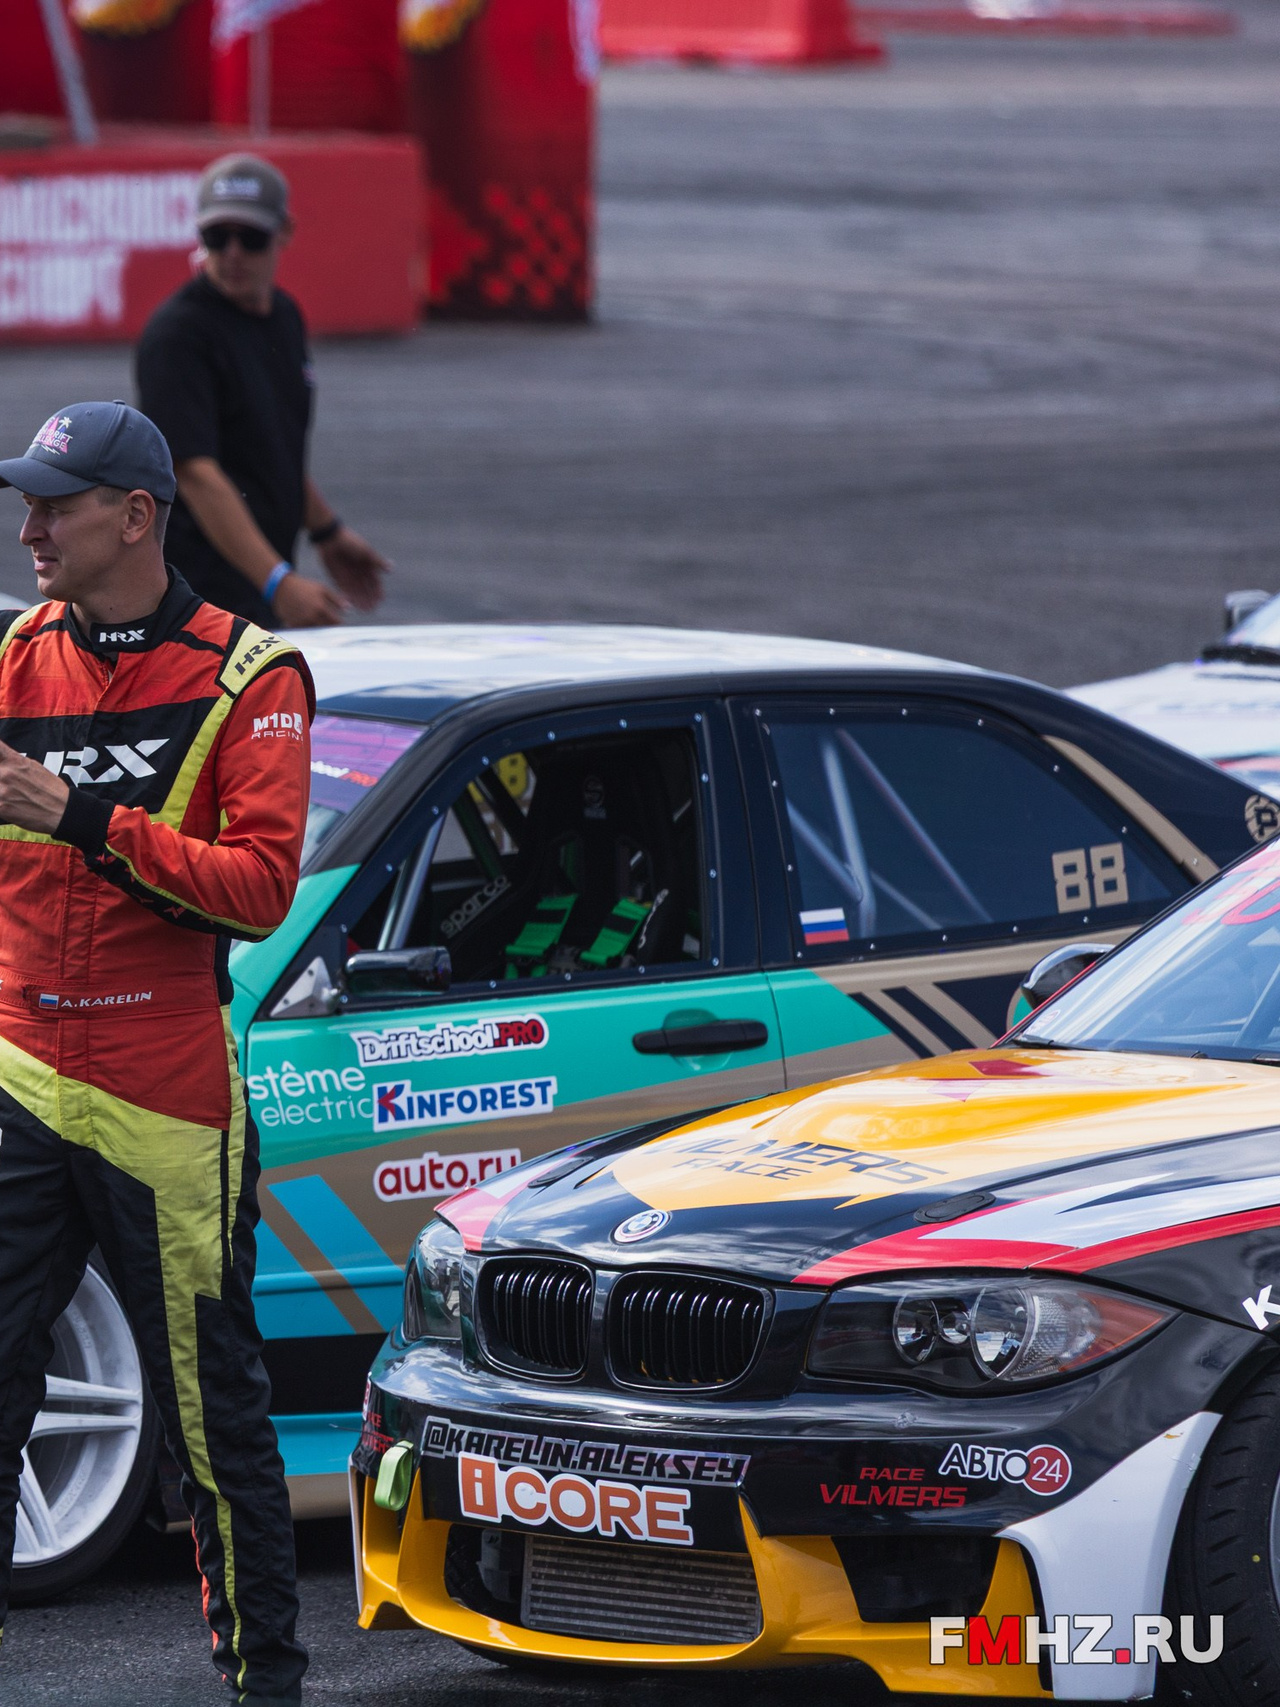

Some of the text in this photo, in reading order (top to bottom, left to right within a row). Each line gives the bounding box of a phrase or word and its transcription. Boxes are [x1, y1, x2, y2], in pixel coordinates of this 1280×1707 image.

[99, 628, 145, 642] HRX
[235, 635, 280, 675] HRX
[1051, 843, 1129, 914] 88
[60, 990, 152, 1008] A.KARELIN
[358, 1019, 544, 1064] Driftschool.PRO
[248, 1061, 367, 1100] stême
[261, 1095, 375, 1127] electric
[377, 1080, 552, 1124] KINFOREST
[859, 1467, 926, 1481] RACE
[819, 1483, 968, 1508] VILMERS
